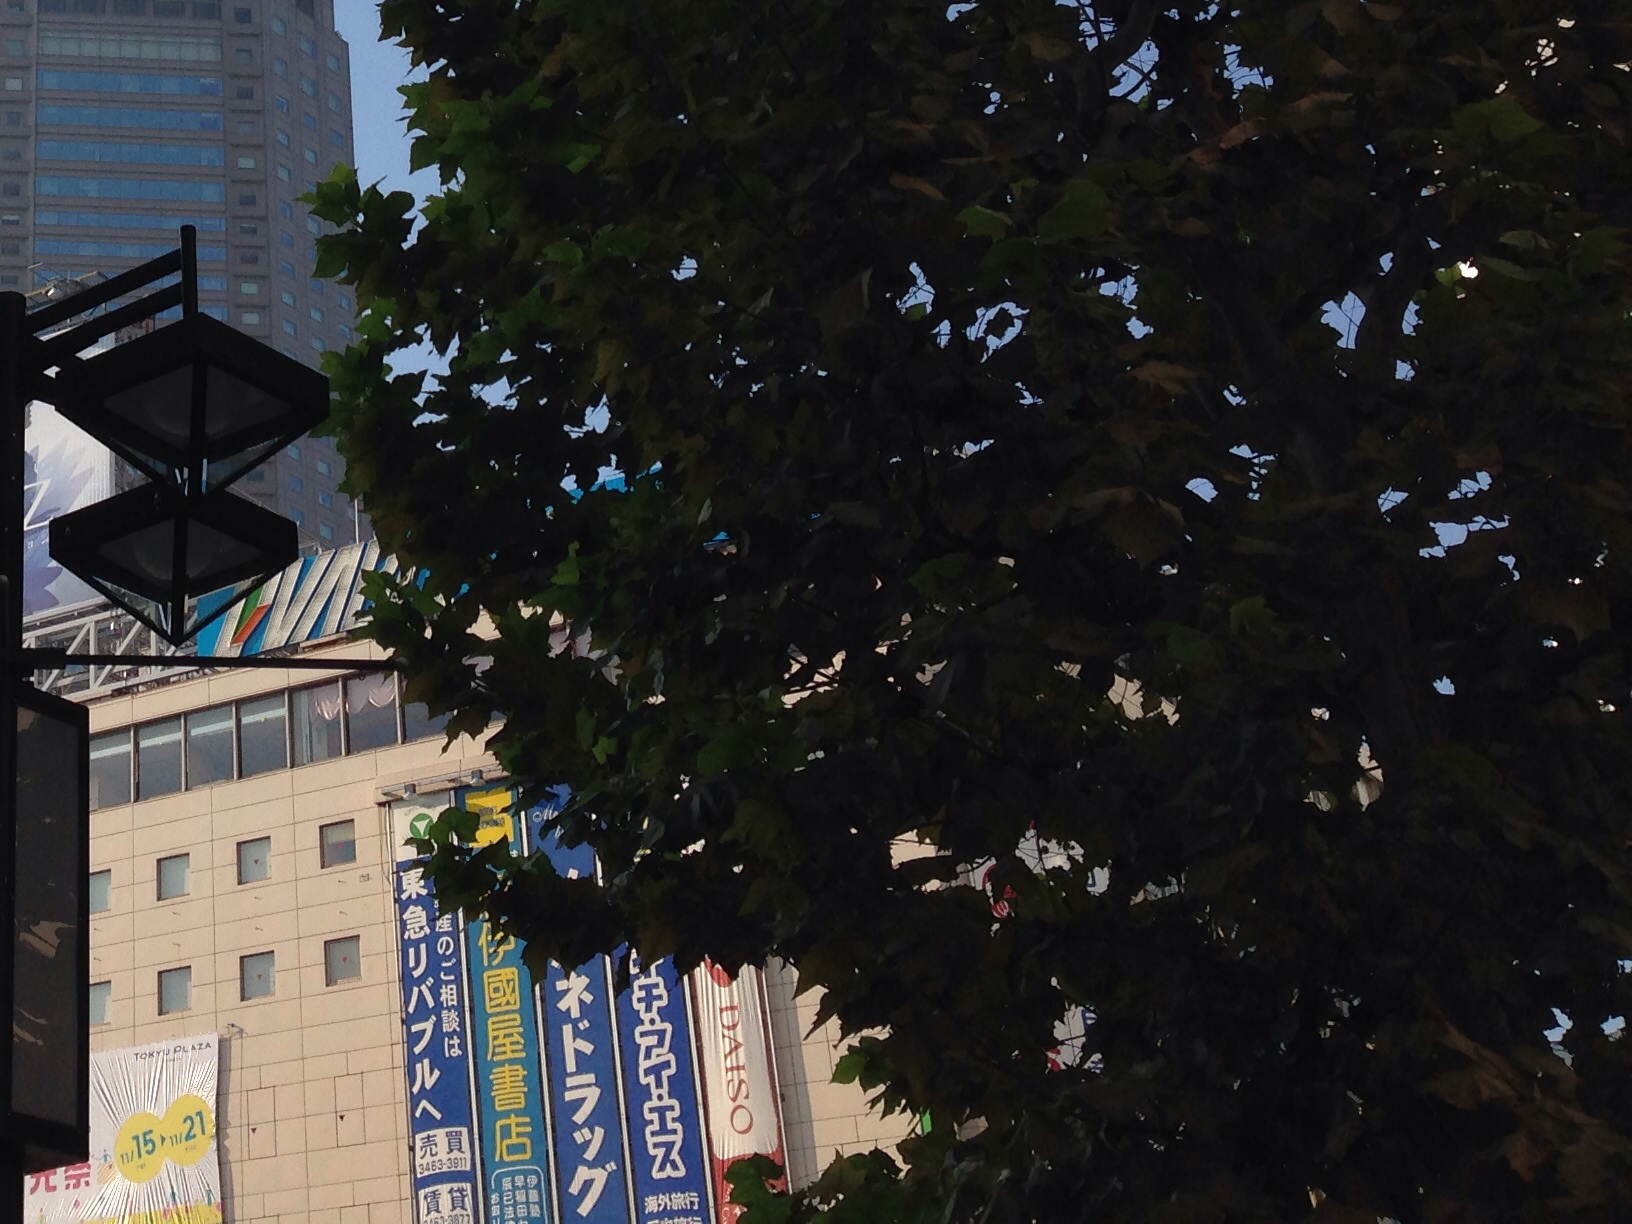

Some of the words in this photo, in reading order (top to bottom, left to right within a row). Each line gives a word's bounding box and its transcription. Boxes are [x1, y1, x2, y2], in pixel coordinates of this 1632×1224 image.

[399, 867, 443, 1122] 東急リバブルへ
[133, 1048, 171, 1062] TOKYU
[173, 1041, 212, 1056] PLAZA
[476, 910, 533, 1162] 伊國屋書店
[719, 1004, 754, 1136] DAISO
[552, 959, 618, 1218] ネドラッグ
[419, 1130, 465, 1160] 売買
[424, 1186, 468, 1217] 賃貸
[644, 1190, 701, 1215] 海外旅行
